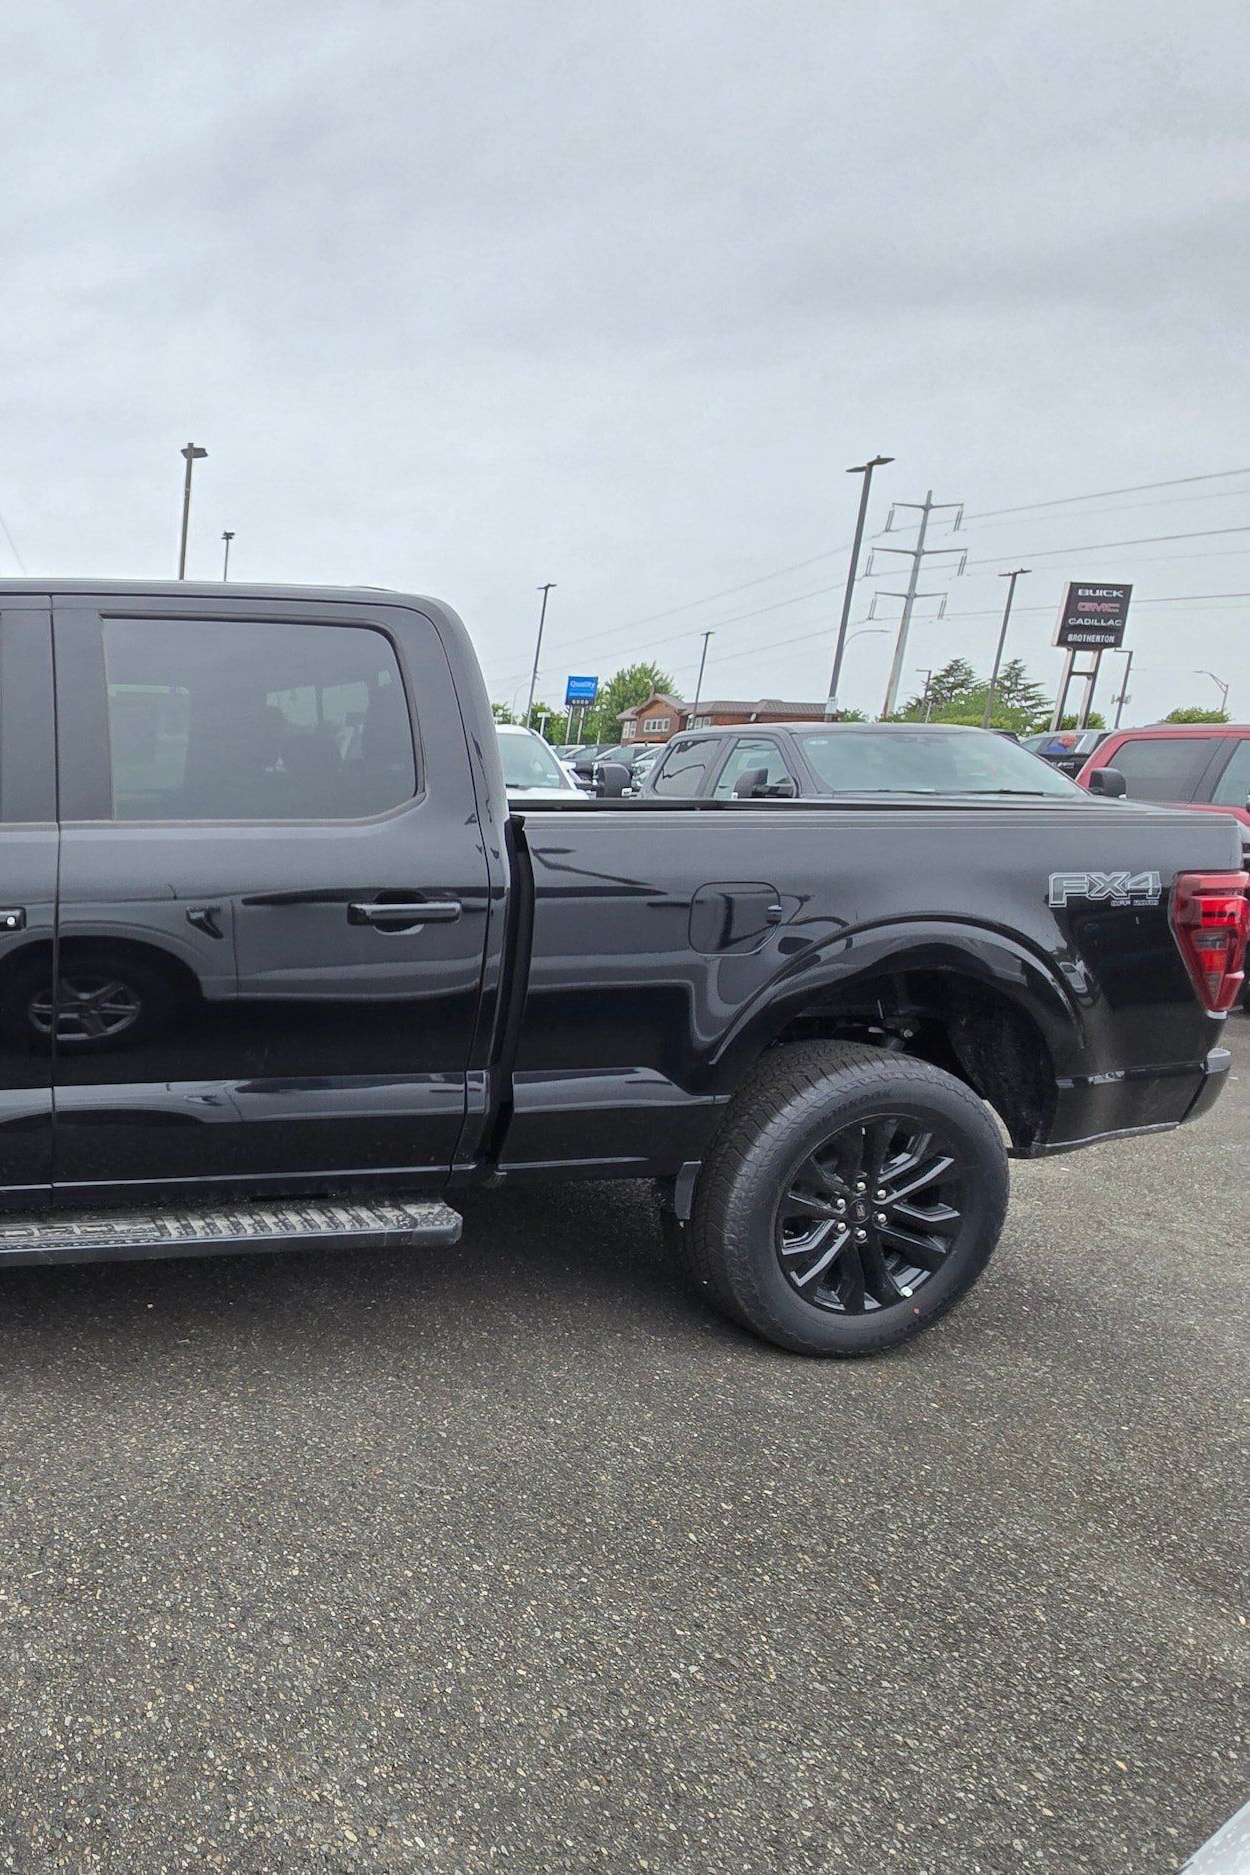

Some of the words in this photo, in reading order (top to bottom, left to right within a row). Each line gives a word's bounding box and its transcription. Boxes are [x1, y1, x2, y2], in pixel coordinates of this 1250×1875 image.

[1077, 588, 1124, 598] BUICK
[1077, 601, 1121, 613] GMC
[1068, 617, 1123, 627] CADILLAC
[1067, 633, 1116, 644] BROTHERTON
[1049, 871, 1162, 908] FX4
